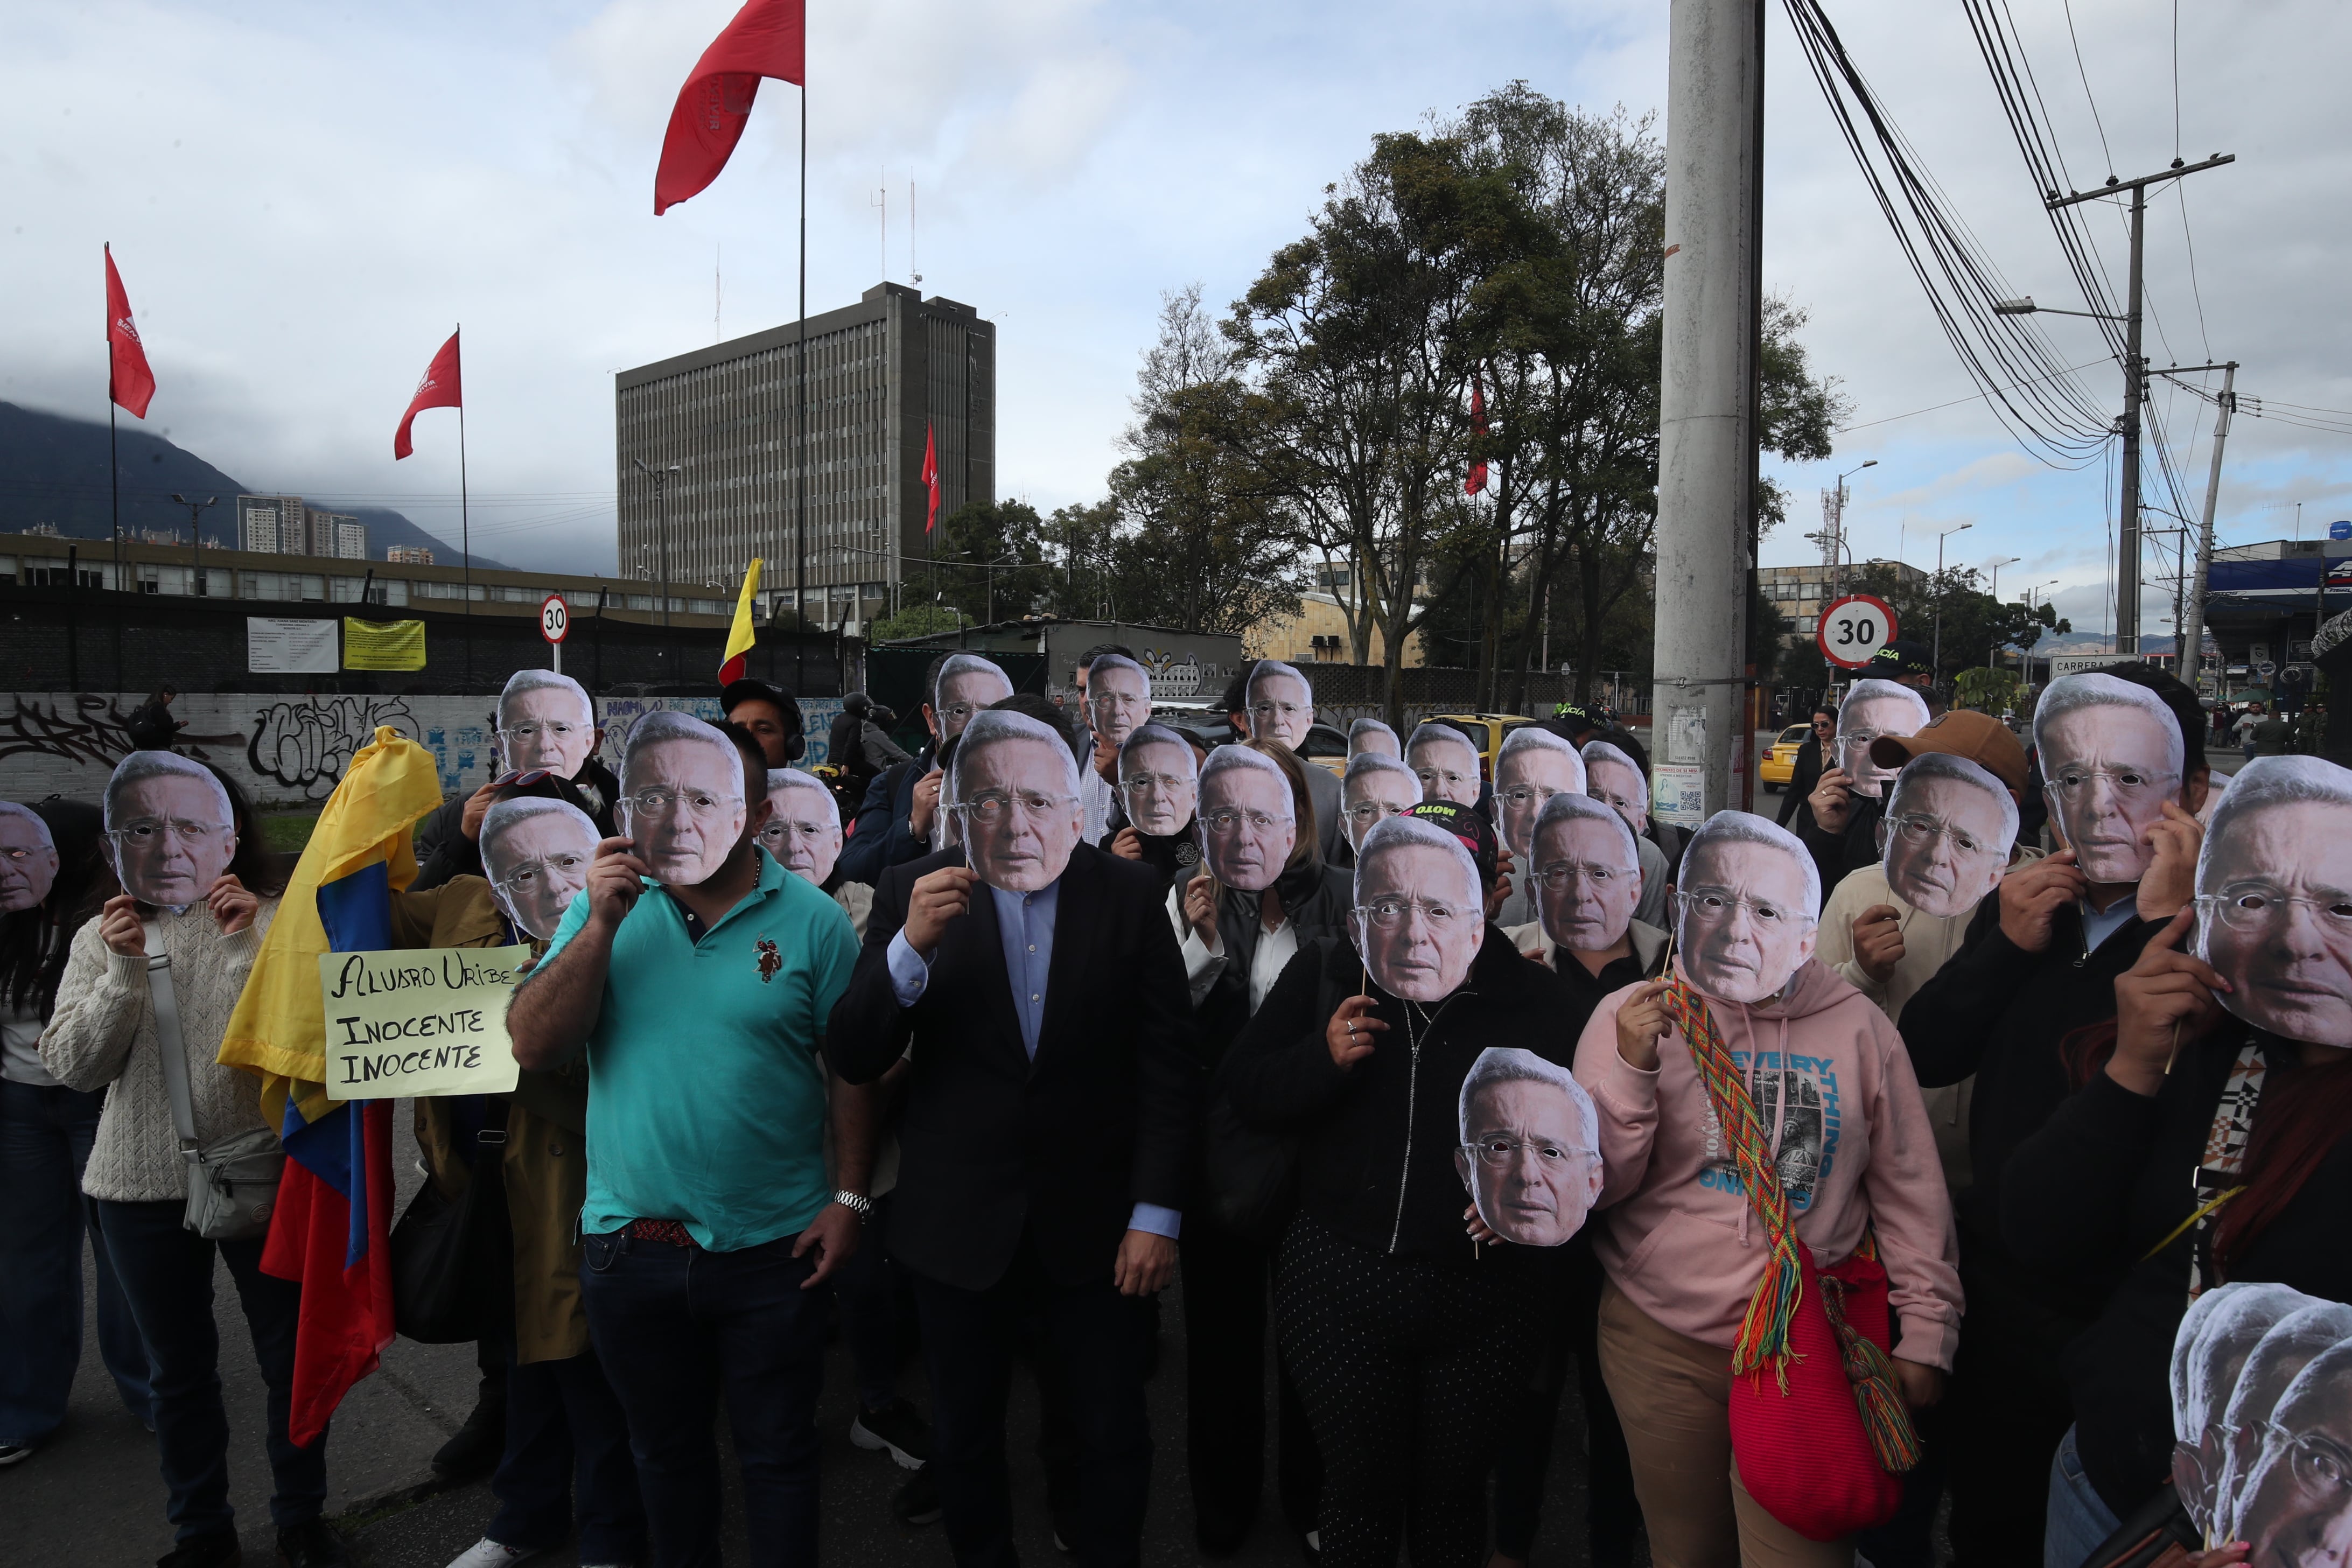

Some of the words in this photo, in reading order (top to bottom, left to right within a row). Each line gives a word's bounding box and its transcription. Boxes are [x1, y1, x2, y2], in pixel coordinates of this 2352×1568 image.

[545, 608, 564, 630] 30
[1837, 619, 1874, 645] 30
[1416, 806, 1457, 816] MOTO
[336, 1010, 484, 1045] INOCENTE
[340, 1045, 482, 1084] INOCENTE
